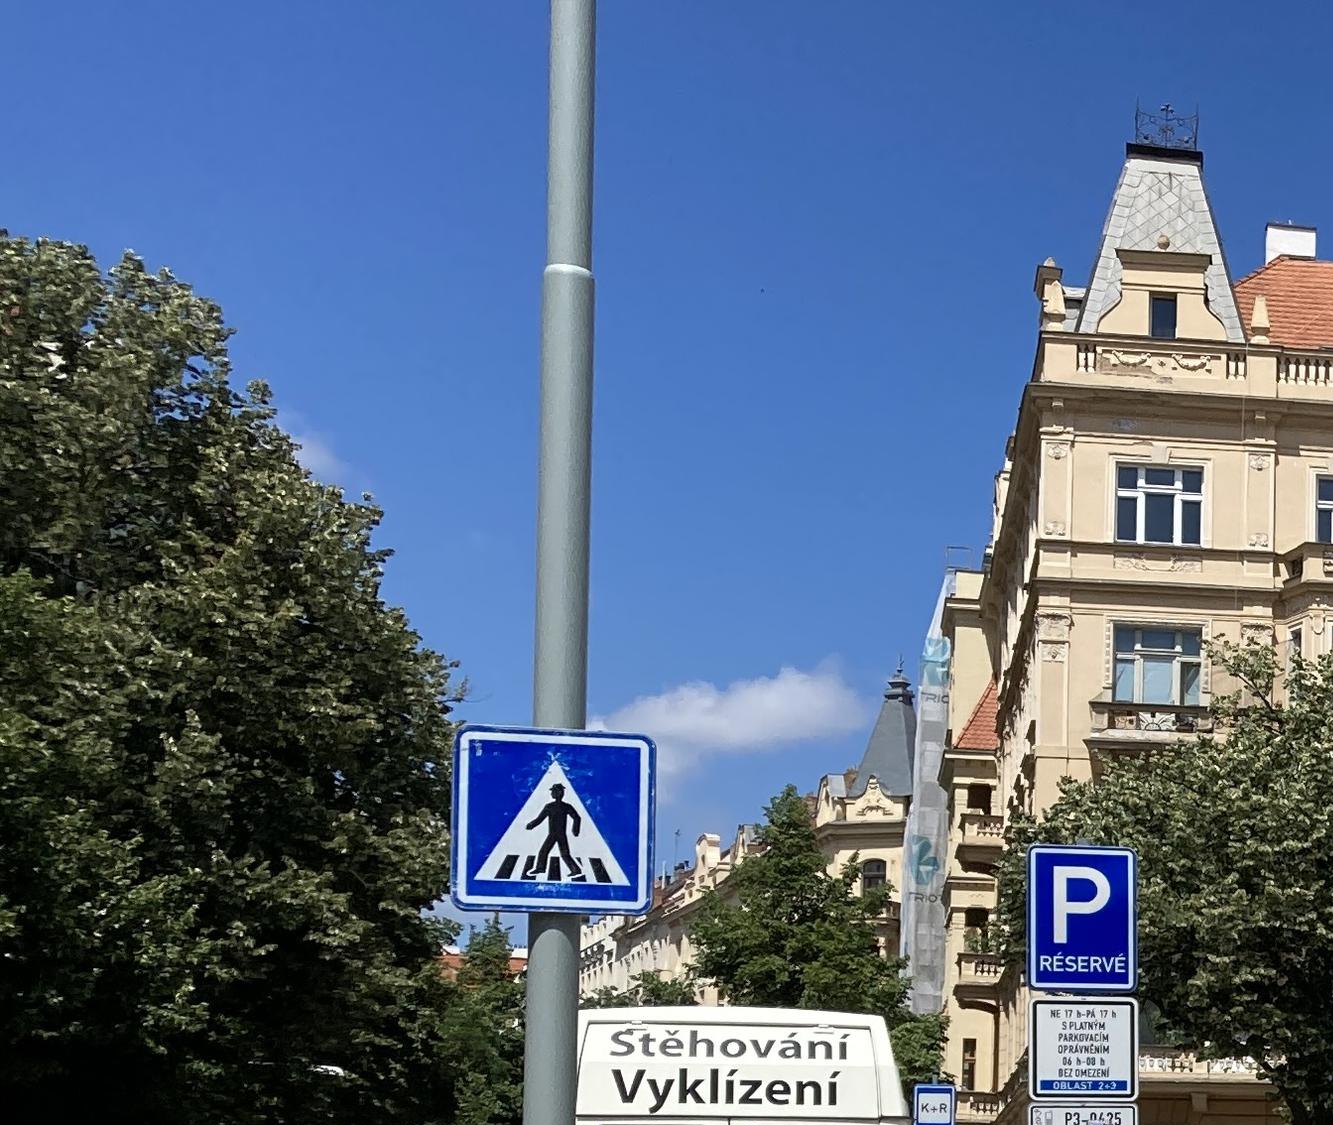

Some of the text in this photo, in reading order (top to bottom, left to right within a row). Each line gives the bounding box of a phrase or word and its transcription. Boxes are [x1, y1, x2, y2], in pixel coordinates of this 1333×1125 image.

[1053, 866, 1111, 944] P
[1040, 952, 1126, 973] RÉSERVÉ
[1050, 1010, 1060, 1018] NE
[1065, 1010, 1072, 1018] 17
[1100, 1010, 1108, 1018] 17
[1112, 1010, 1116, 1018] h
[1062, 1020, 1106, 1030] S PLATNÝM
[1058, 1032, 1109, 1042] PARKOVACÍM
[610, 1030, 850, 1060] Stěhování
[1058, 1044, 1110, 1054] OPRÁVNĚNÍM
[1062, 1057, 1072, 1065] 06
[1058, 1067, 1110, 1078] BEZ OMEZENÍ
[611, 1068, 841, 1114] Vyklízení
[1053, 1082, 1116, 1090] OBLAST 2+3
[921, 1103, 947, 1113] K+R
